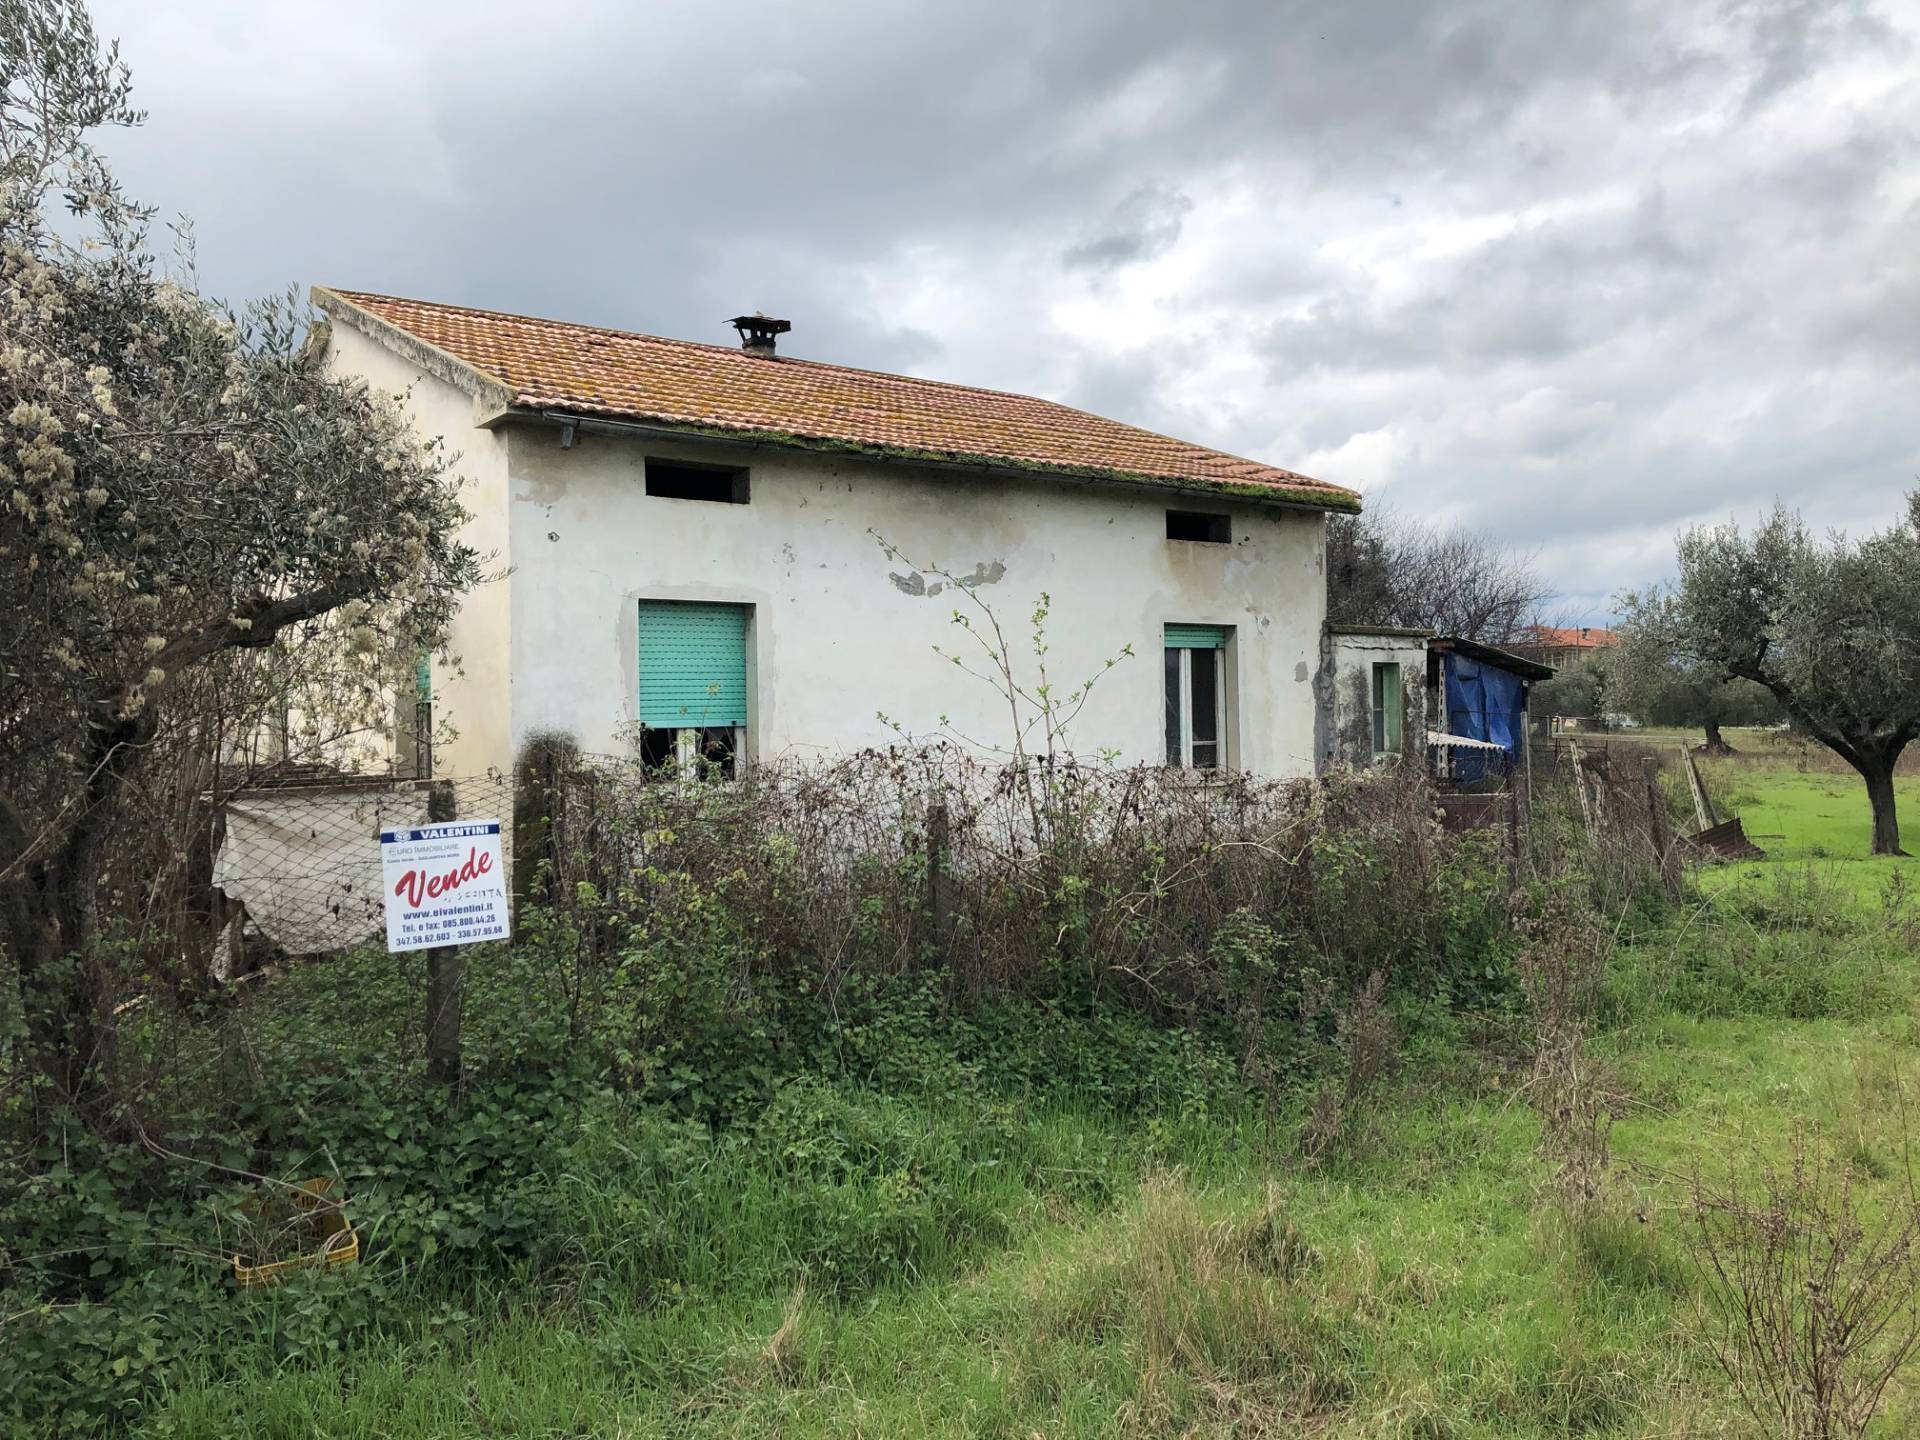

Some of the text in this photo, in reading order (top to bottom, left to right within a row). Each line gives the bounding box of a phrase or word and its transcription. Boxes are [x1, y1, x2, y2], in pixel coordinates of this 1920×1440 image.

[419, 825, 489, 839] VALENTINI
[395, 846, 493, 907] Vende
[402, 924, 416, 933] Tel.
